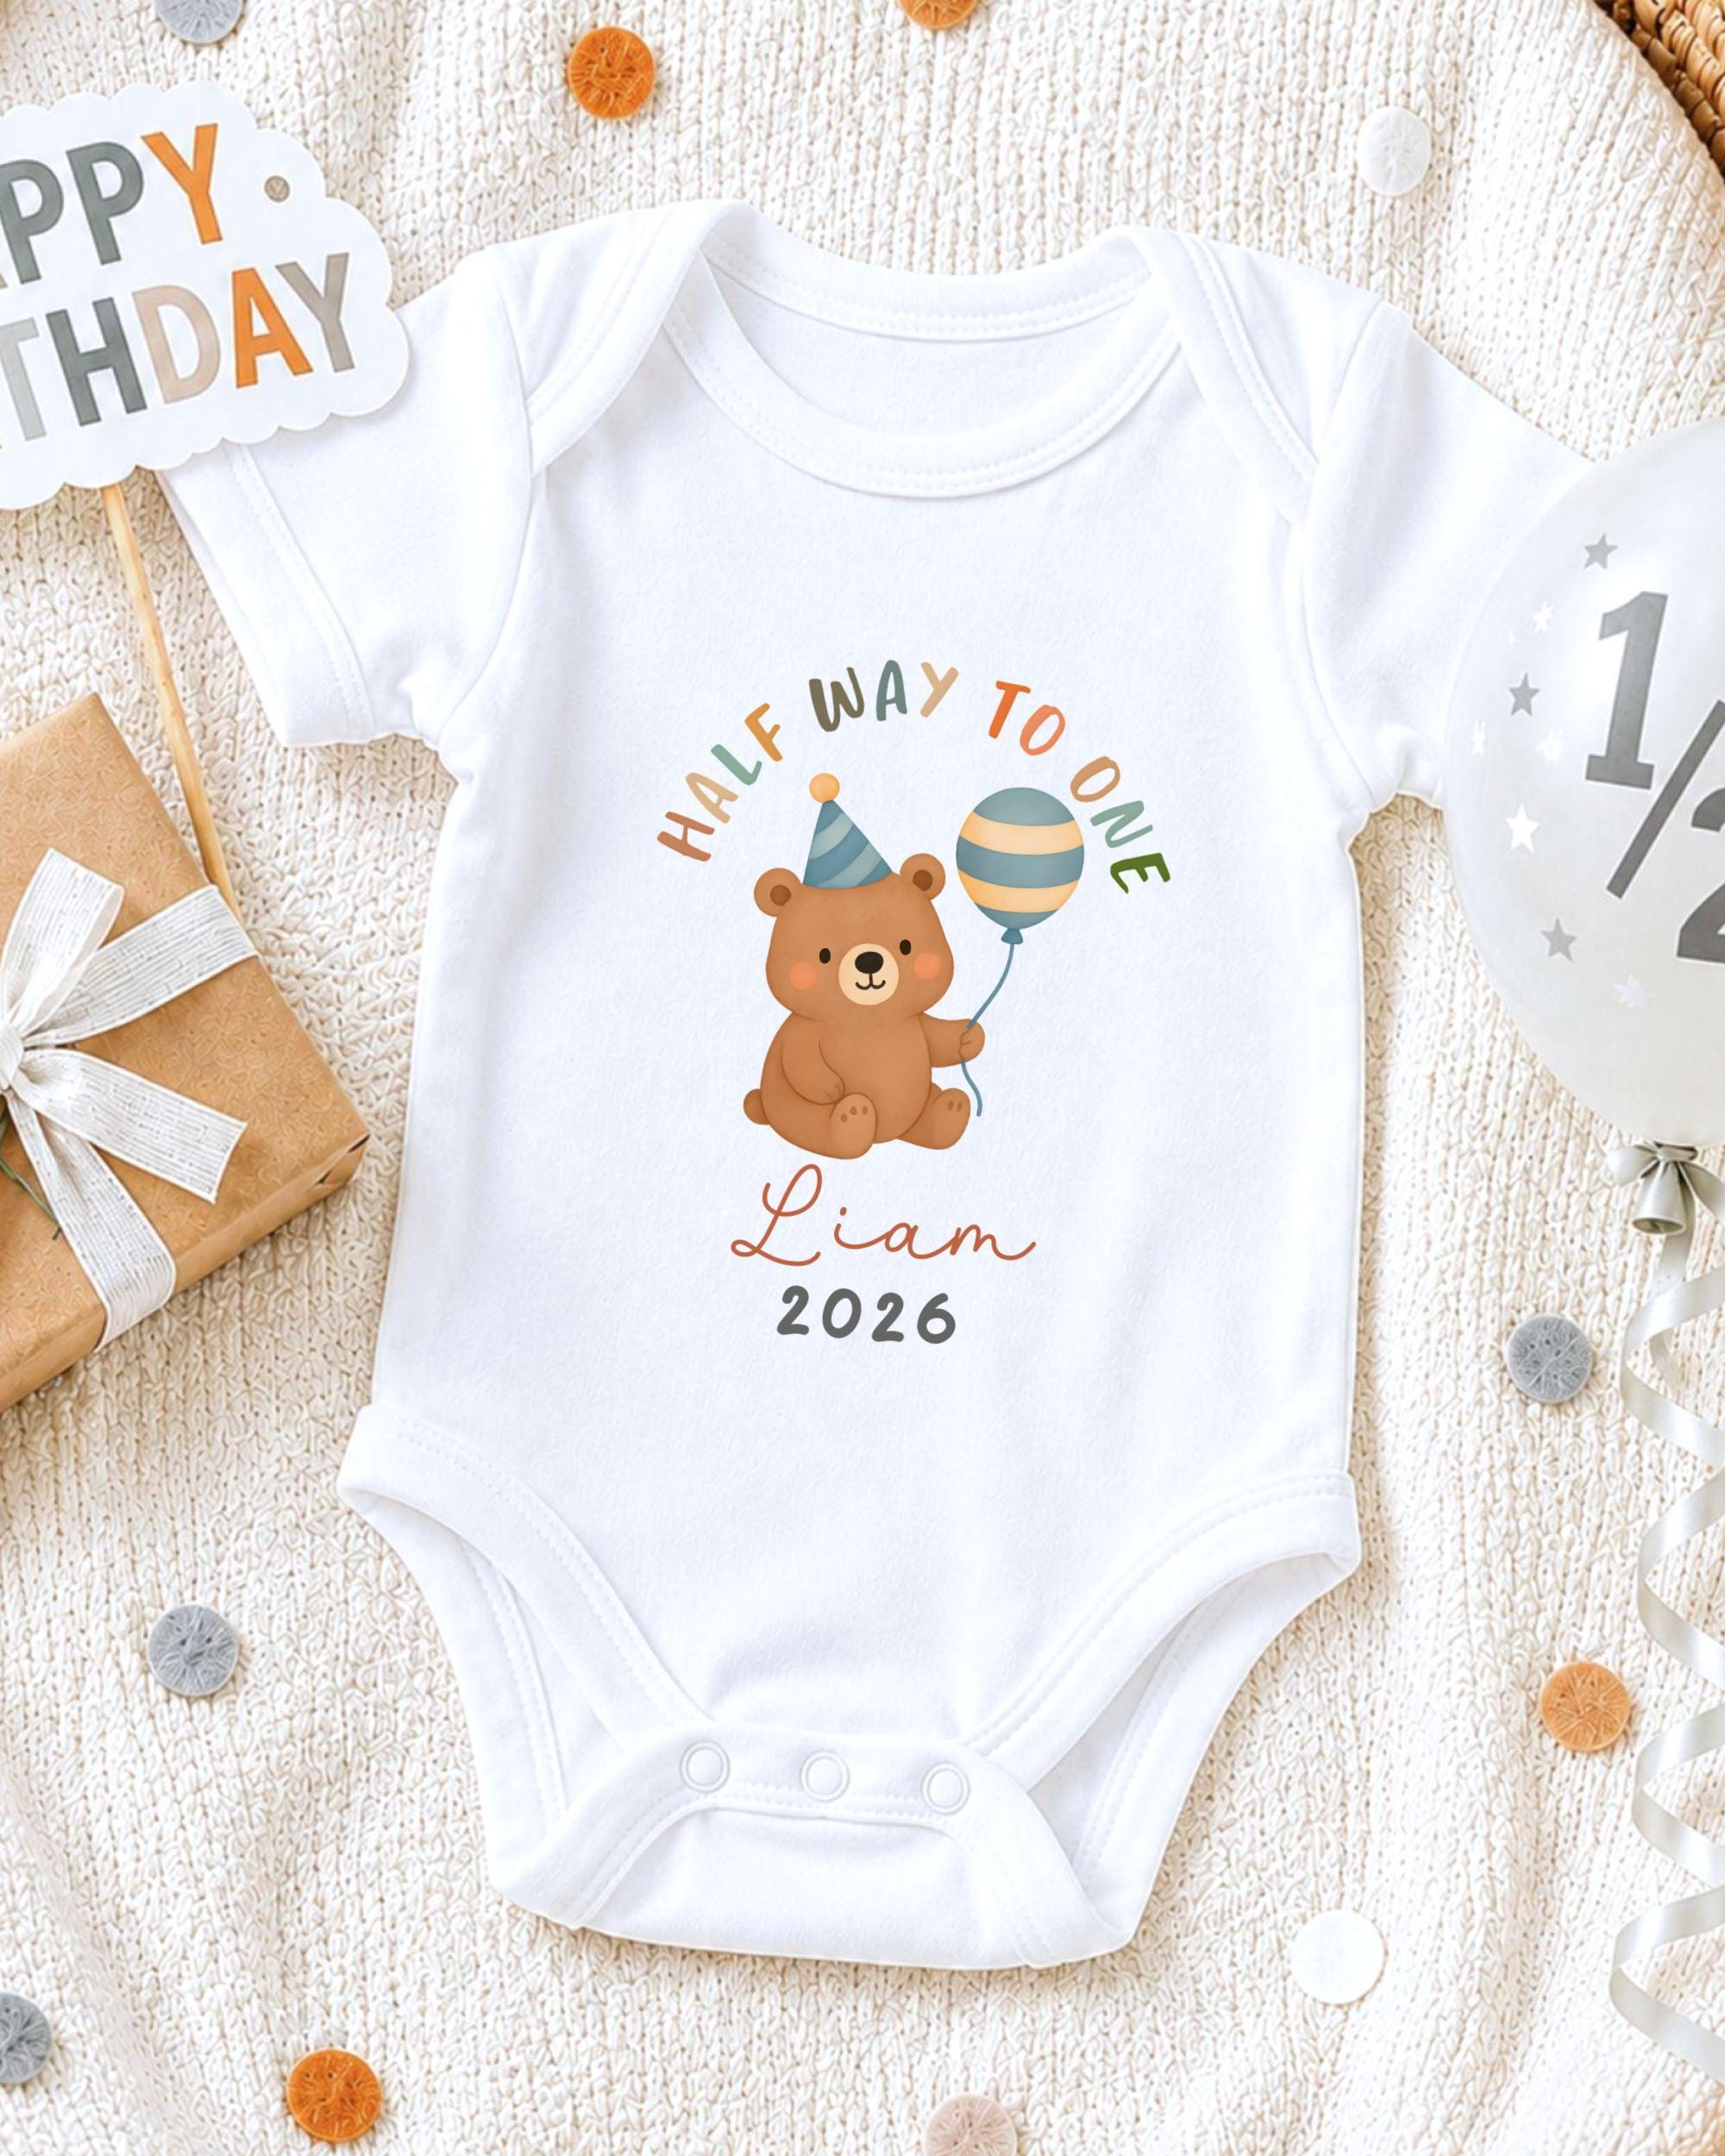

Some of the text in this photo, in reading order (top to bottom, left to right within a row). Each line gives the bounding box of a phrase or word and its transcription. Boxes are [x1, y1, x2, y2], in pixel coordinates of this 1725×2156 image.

[0, 122, 223, 288] PPY
[0, 252, 355, 449] THDAY
[656, 659, 1171, 894] HALF WAY TO ONE
[730, 1163, 1037, 1267] Liam
[776, 1284, 957, 1344] 2026
